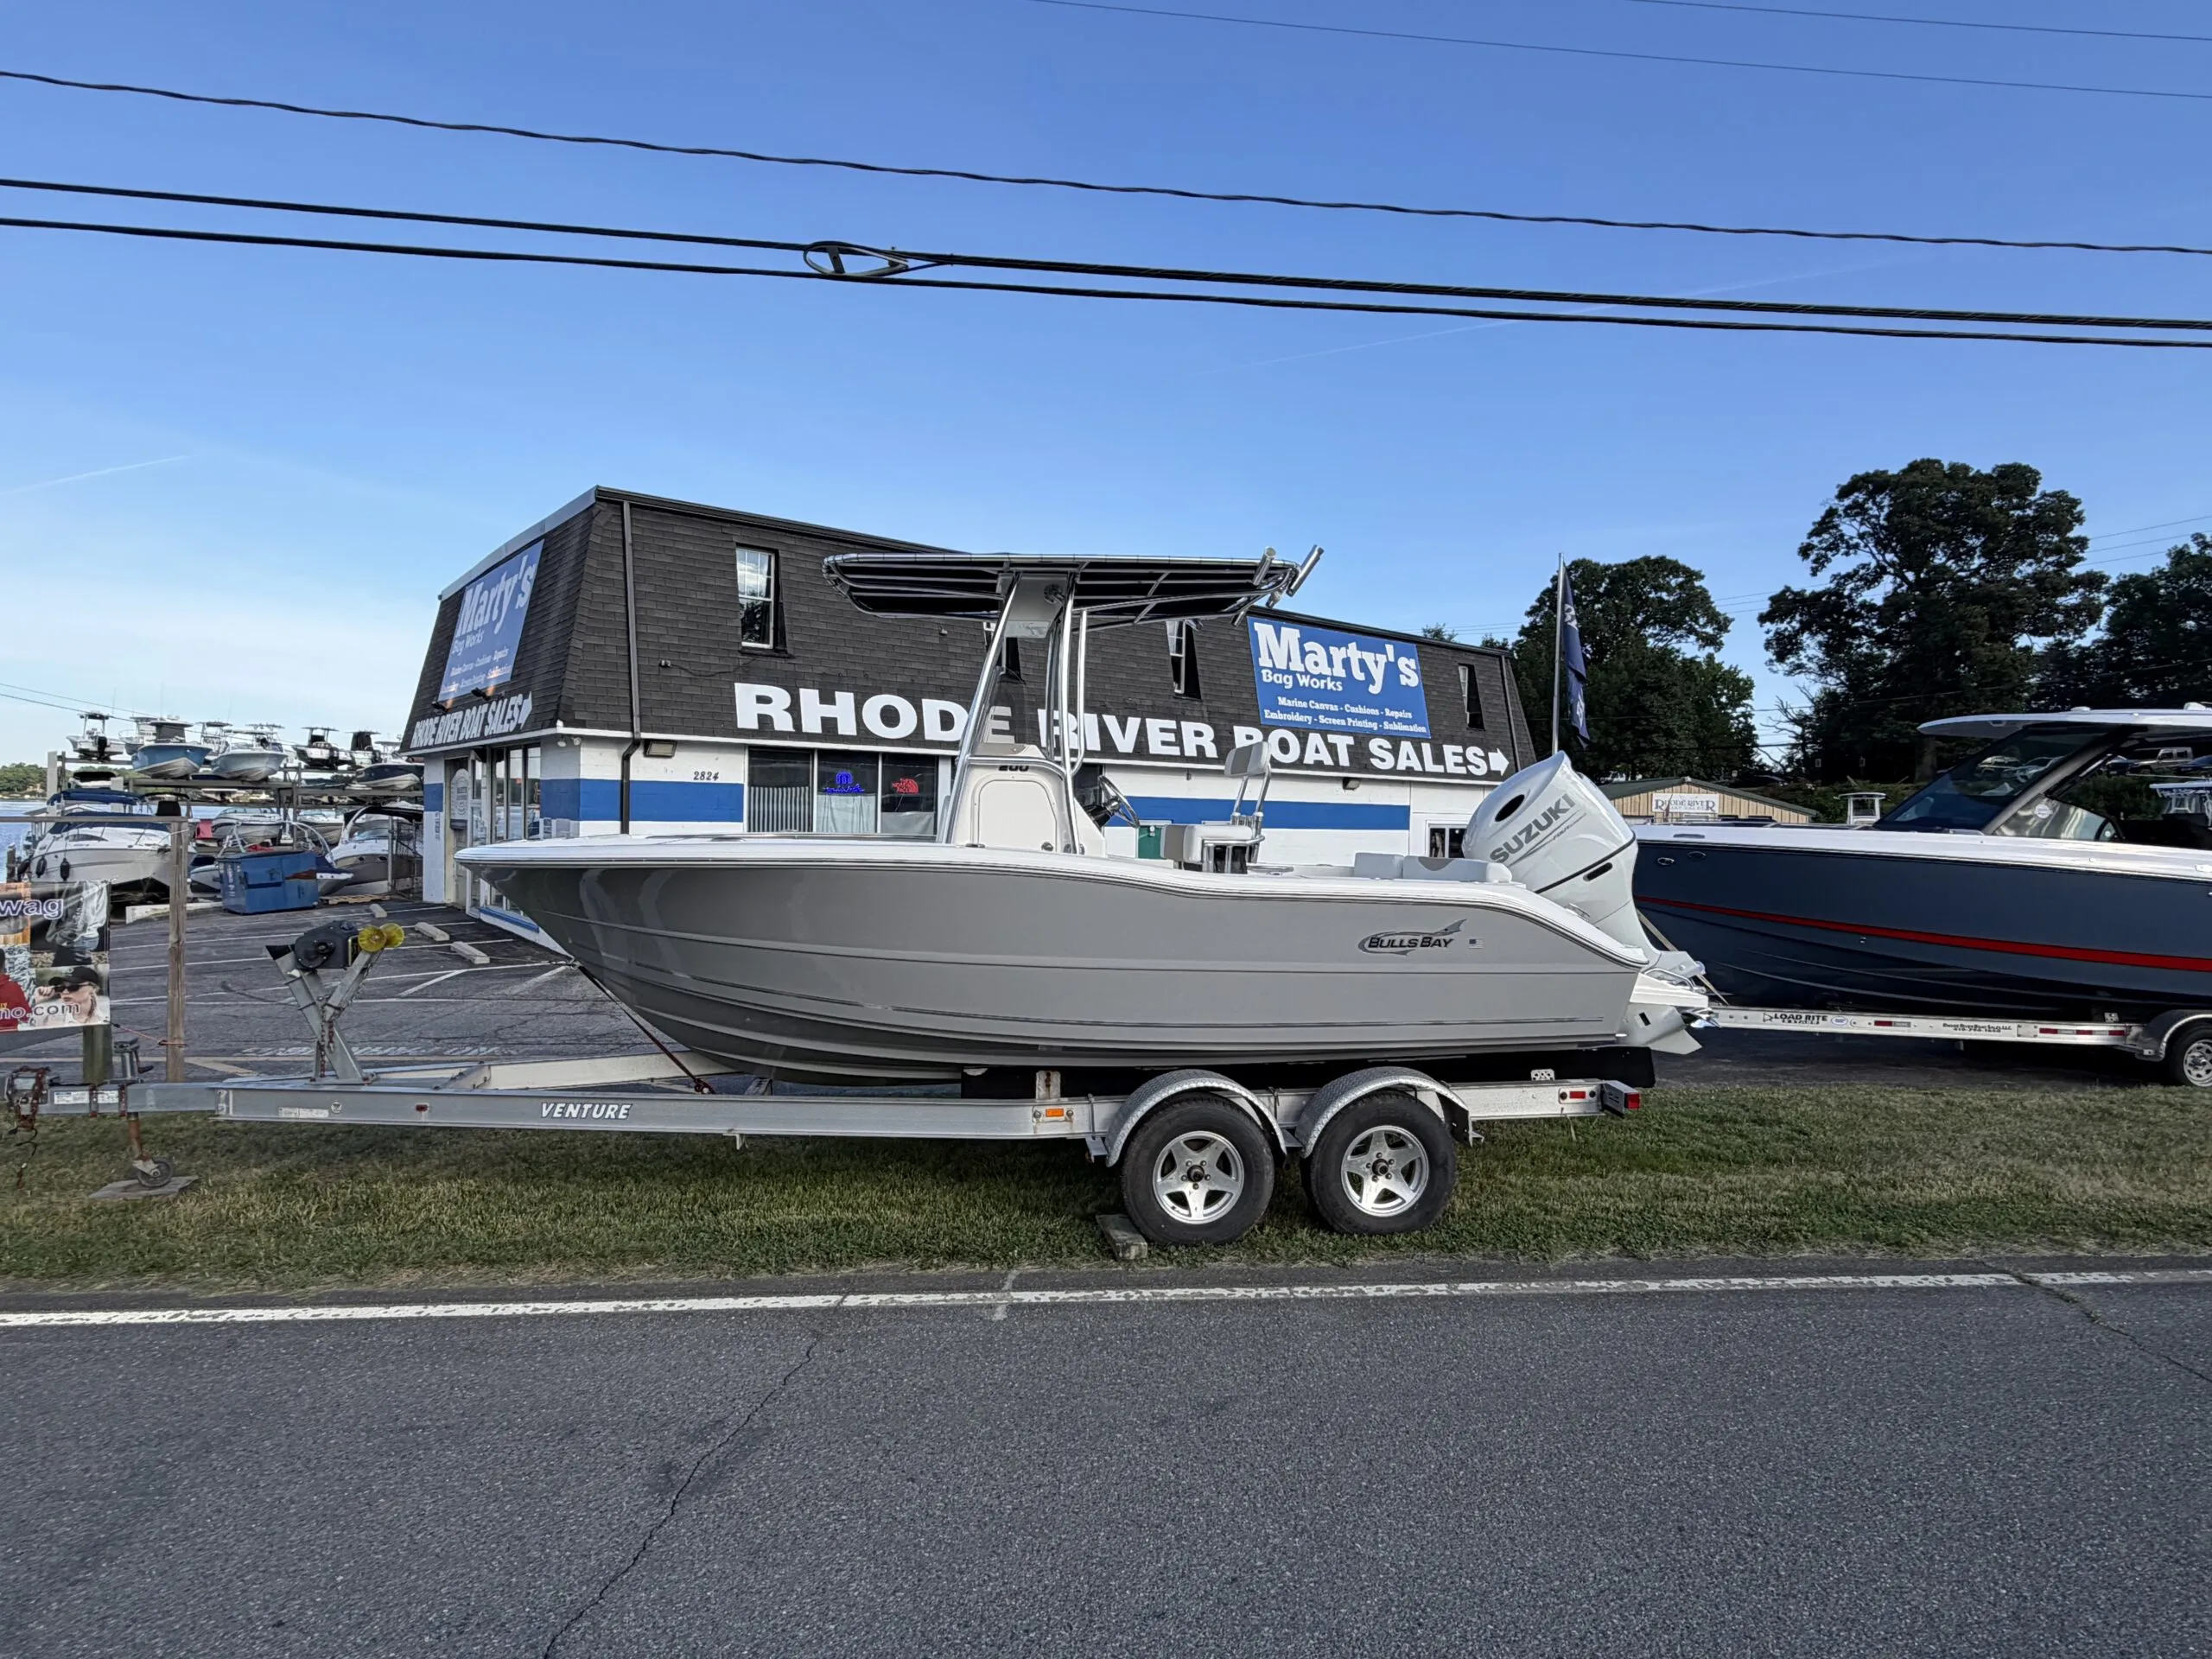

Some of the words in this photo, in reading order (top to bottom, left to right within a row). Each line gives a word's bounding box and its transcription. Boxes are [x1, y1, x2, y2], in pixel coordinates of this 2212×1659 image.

[455, 555, 537, 638] Marty's
[1253, 622, 1420, 694] Marty's
[1261, 669, 1294, 690] Bag
[1297, 673, 1344, 691] Works
[1278, 696, 1307, 709] Marine
[1309, 700, 1338, 712] Canvas
[1344, 703, 1380, 715] Cushions
[1384, 708, 1413, 719] Repairs
[410, 716, 439, 748] RHODE
[435, 710, 464, 745] RIVER
[460, 703, 489, 741] BOAT
[484, 694, 523, 736] SALES
[734, 683, 1015, 744] RHODE
[1037, 709, 1218, 759] RIVER
[1369, 738, 1489, 777] SALES
[1264, 709, 1313, 725] Embroidery
[1319, 715, 1346, 727] Screen
[1347, 717, 1377, 730] Printing
[1383, 721, 1427, 734] Sublimation
[693, 771, 720, 781] 2824
[1490, 793, 1576, 863] SUZUKI
[0, 899, 64, 920] wag
[541, 1102, 633, 1120] VENTURE
